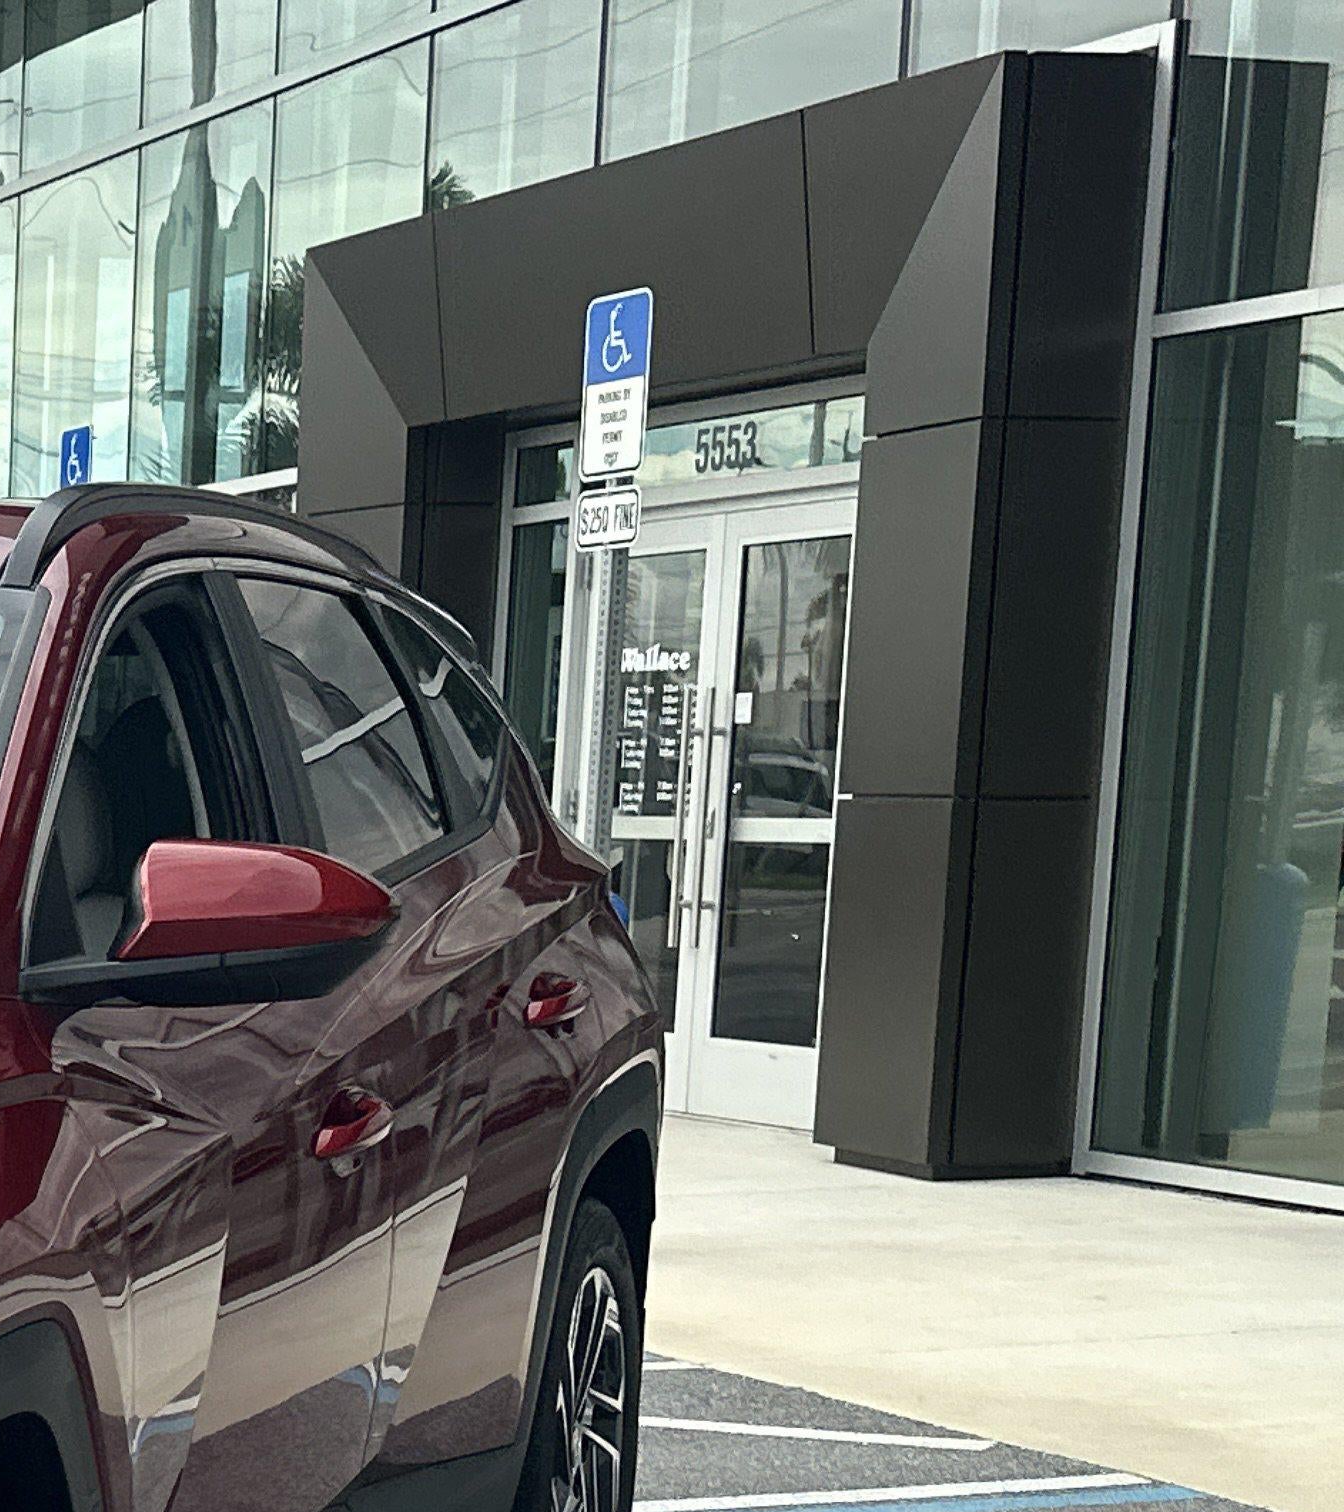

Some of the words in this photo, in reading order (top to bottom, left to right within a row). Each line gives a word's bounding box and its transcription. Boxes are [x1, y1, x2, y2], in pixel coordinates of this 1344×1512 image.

[695, 421, 757, 473] 5553
[580, 505, 609, 536] $250
[614, 502, 636, 532] FINE
[621, 643, 691, 673] Wallace
